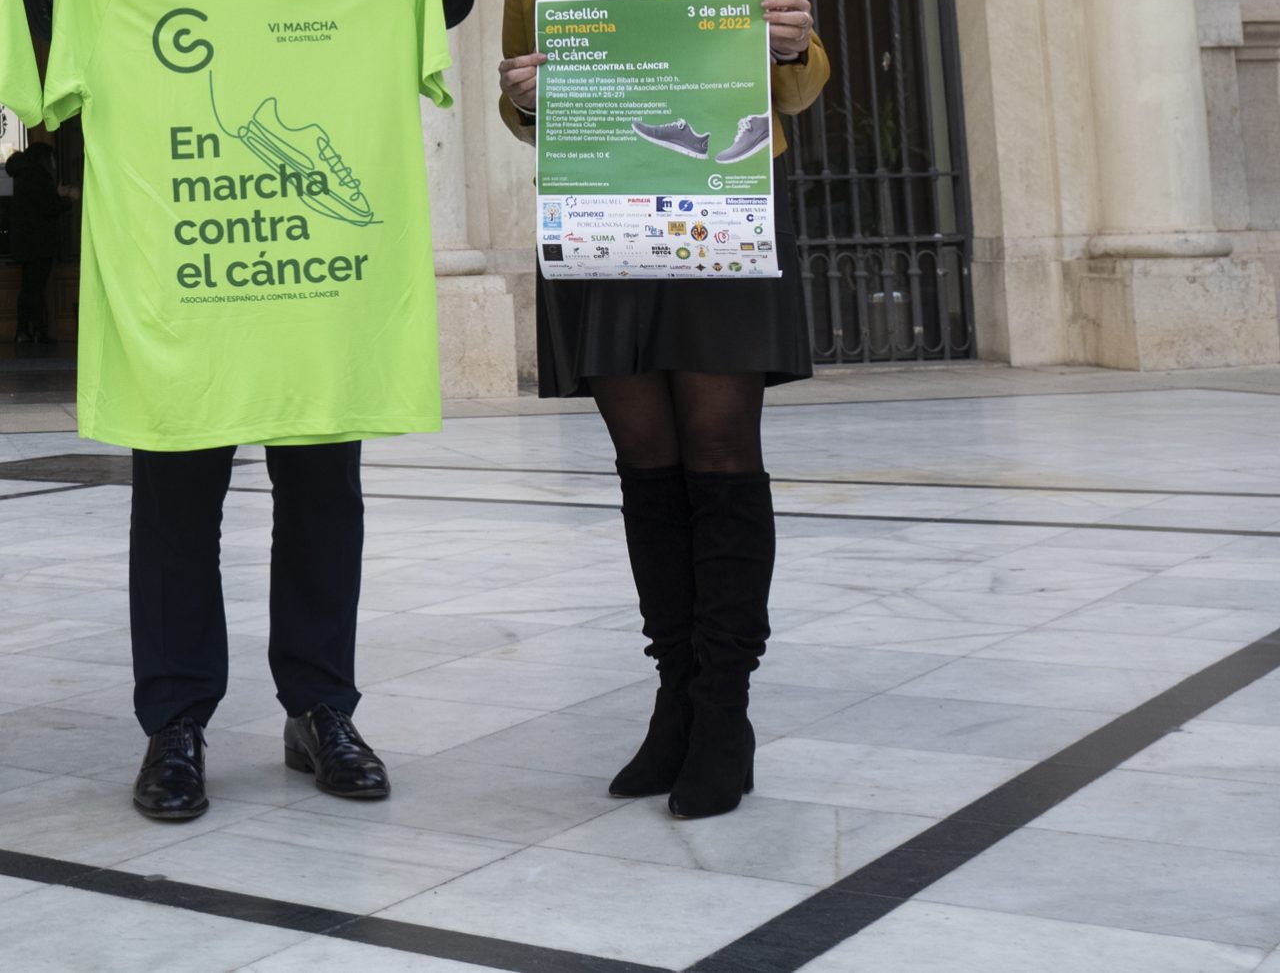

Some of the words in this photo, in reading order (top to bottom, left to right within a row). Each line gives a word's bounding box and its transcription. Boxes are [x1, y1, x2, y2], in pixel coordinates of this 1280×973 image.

[545, 7, 608, 21] Castellón
[688, 6, 696, 17] 3
[699, 5, 716, 17] de
[720, 4, 750, 16] abril
[268, 23, 280, 33] VI
[284, 21, 338, 32] MARCHA
[545, 25, 562, 35] en
[565, 21, 616, 33] marcha
[698, 19, 715, 30] de
[719, 17, 751, 29] 2022
[288, 33, 332, 43] CASTELLÓN
[546, 36, 589, 47] contra
[547, 49, 560, 61] el
[562, 49, 608, 61] cáncer
[592, 63, 625, 71] CONTRA
[636, 61, 669, 69] CÁNCER
[170, 126, 220, 160] En
[579, 151, 594, 159] pack
[172, 164, 329, 203] marcha
[568, 210, 604, 219] younexa
[174, 209, 310, 247] contra
[176, 253, 217, 289] el
[226, 249, 368, 287] cáncer
[180, 295, 225, 303] ASOCIACIÓN
[226, 294, 266, 303] ESPAÑOLA
[267, 293, 298, 301] CONTRA
[309, 291, 339, 299] CÁNCER
